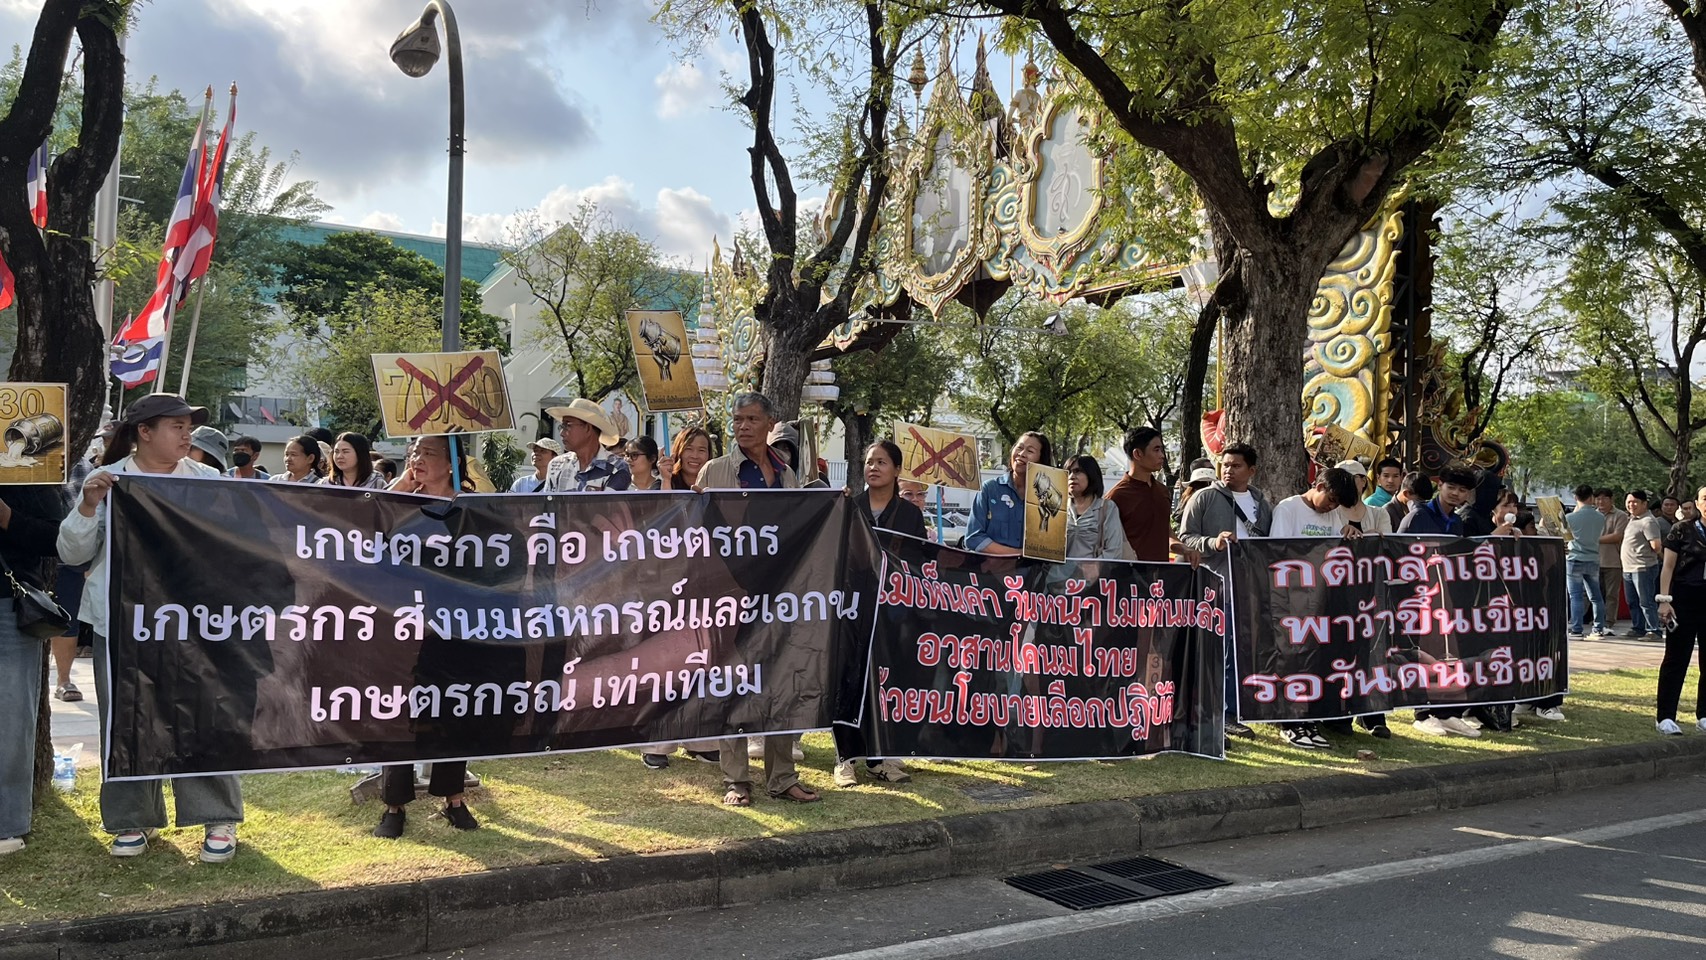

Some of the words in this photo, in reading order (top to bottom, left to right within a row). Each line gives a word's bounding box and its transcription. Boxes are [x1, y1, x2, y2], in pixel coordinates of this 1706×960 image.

[296, 525, 512, 567] เกษตรกร
[527, 512, 587, 565] คือ
[603, 525, 779, 562] เกษตรกร
[132, 603, 377, 641] เกษตรกร
[917, 623, 1138, 677] อวสานโคนมไทย
[310, 656, 582, 722] เกษตรกรณ์
[592, 649, 762, 708] เท่าเทียม
